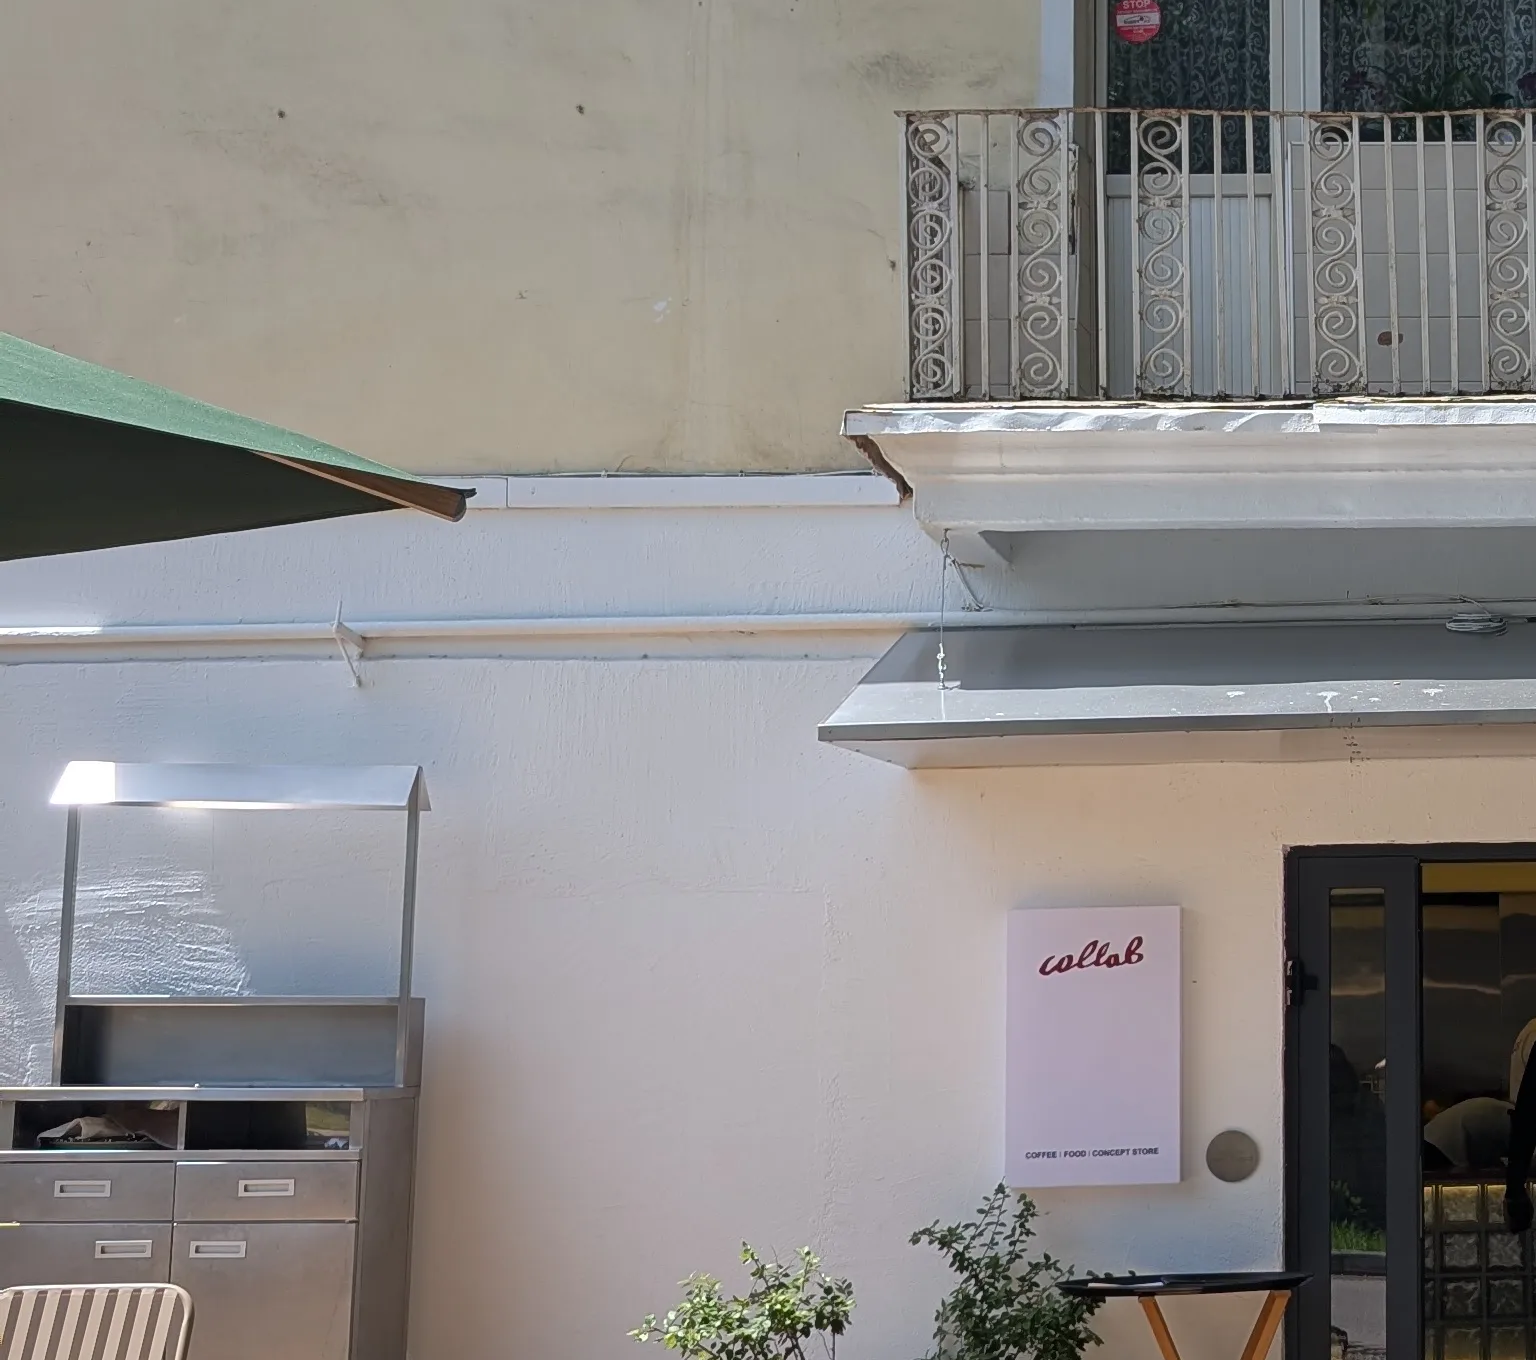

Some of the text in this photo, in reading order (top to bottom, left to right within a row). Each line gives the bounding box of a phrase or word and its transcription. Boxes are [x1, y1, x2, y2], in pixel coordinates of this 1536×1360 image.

[1122, 0, 1151, 9] STOP
[1038, 936, 1144, 976] collab
[1025, 1147, 1159, 1159] COFFEE FOOD CONCEPT STORE
